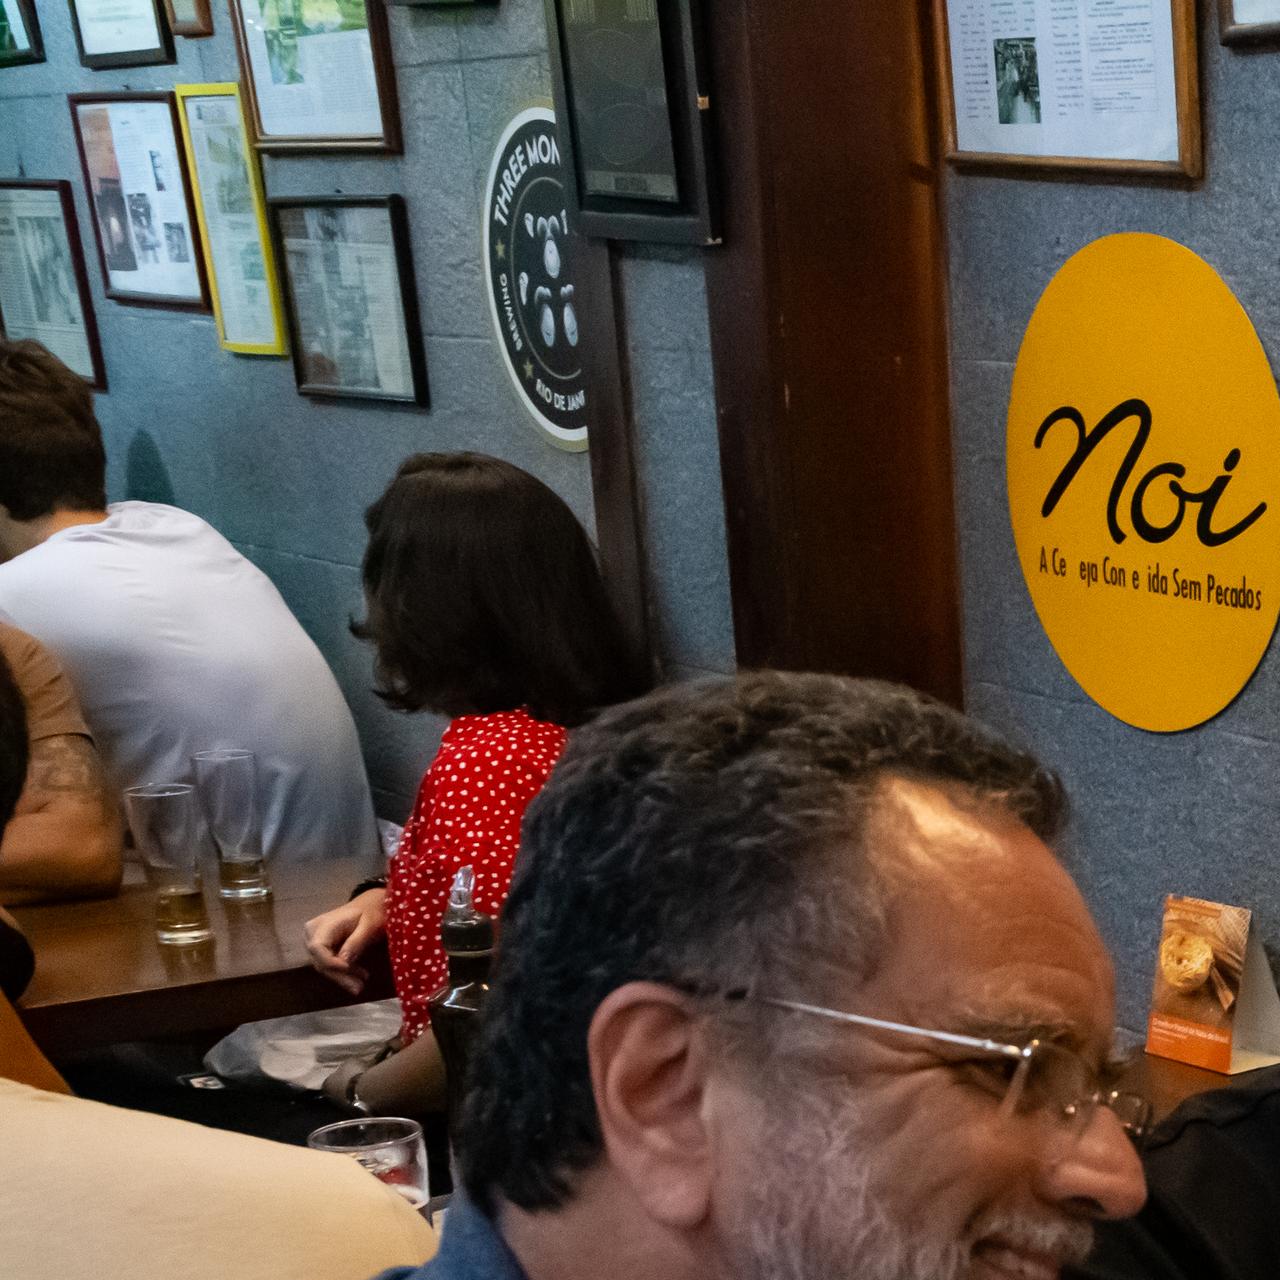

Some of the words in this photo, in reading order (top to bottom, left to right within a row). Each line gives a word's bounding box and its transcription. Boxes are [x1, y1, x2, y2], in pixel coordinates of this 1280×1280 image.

[494, 144, 528, 227] THREE
[499, 273, 523, 352] BREWING
[535, 378, 552, 403] RIO
[554, 393, 566, 411] DE
[1040, 546, 1048, 573] A
[1173, 568, 1202, 602] Sem
[1207, 574, 1262, 611] Pecados
